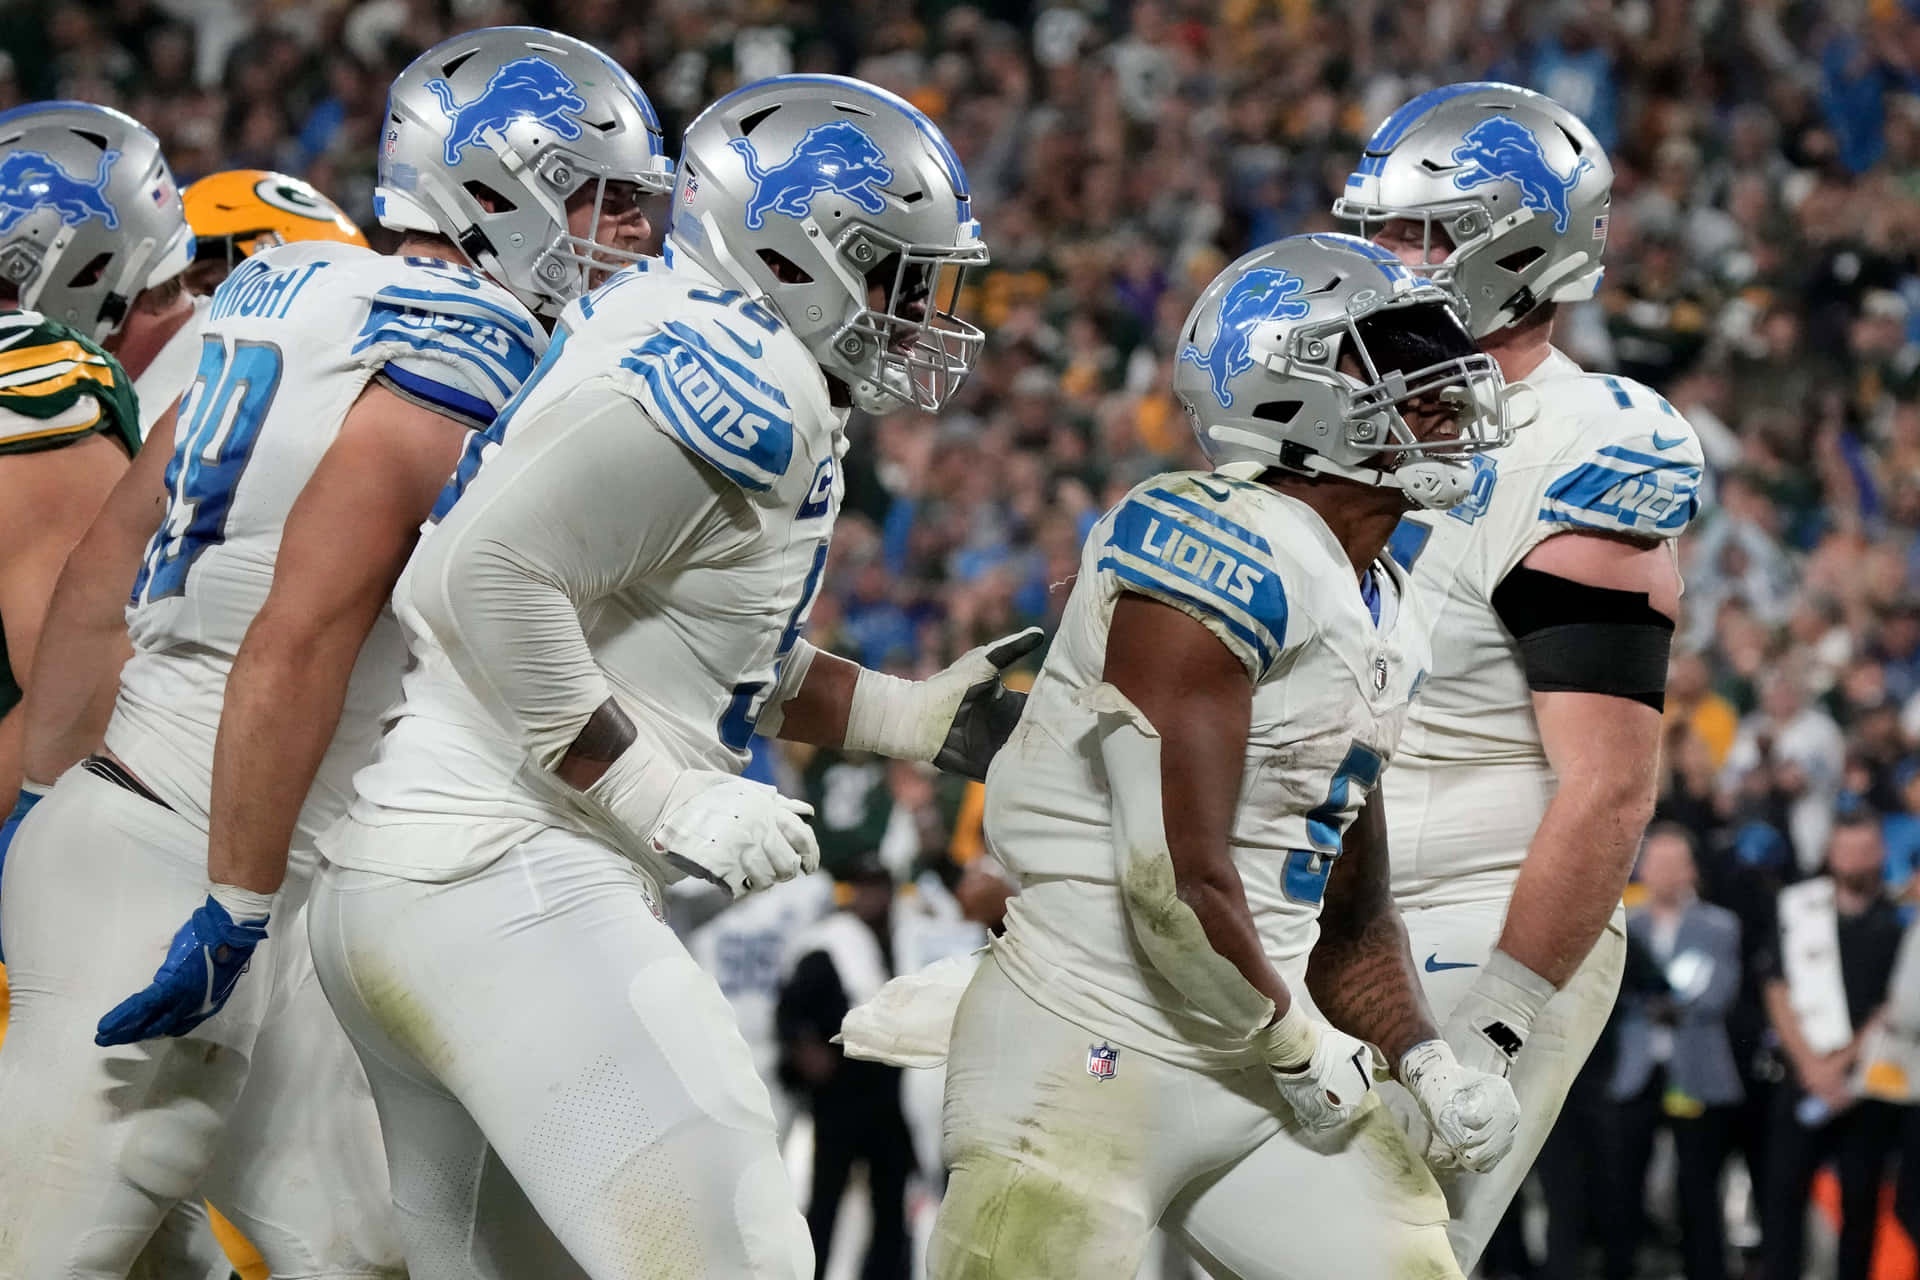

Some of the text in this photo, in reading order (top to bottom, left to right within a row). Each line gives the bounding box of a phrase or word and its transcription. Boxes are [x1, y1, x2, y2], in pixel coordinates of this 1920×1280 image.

[663, 346, 771, 451] LIONS
[1141, 517, 1265, 606] LIONS
[1091, 1059, 1113, 1075] NFL
